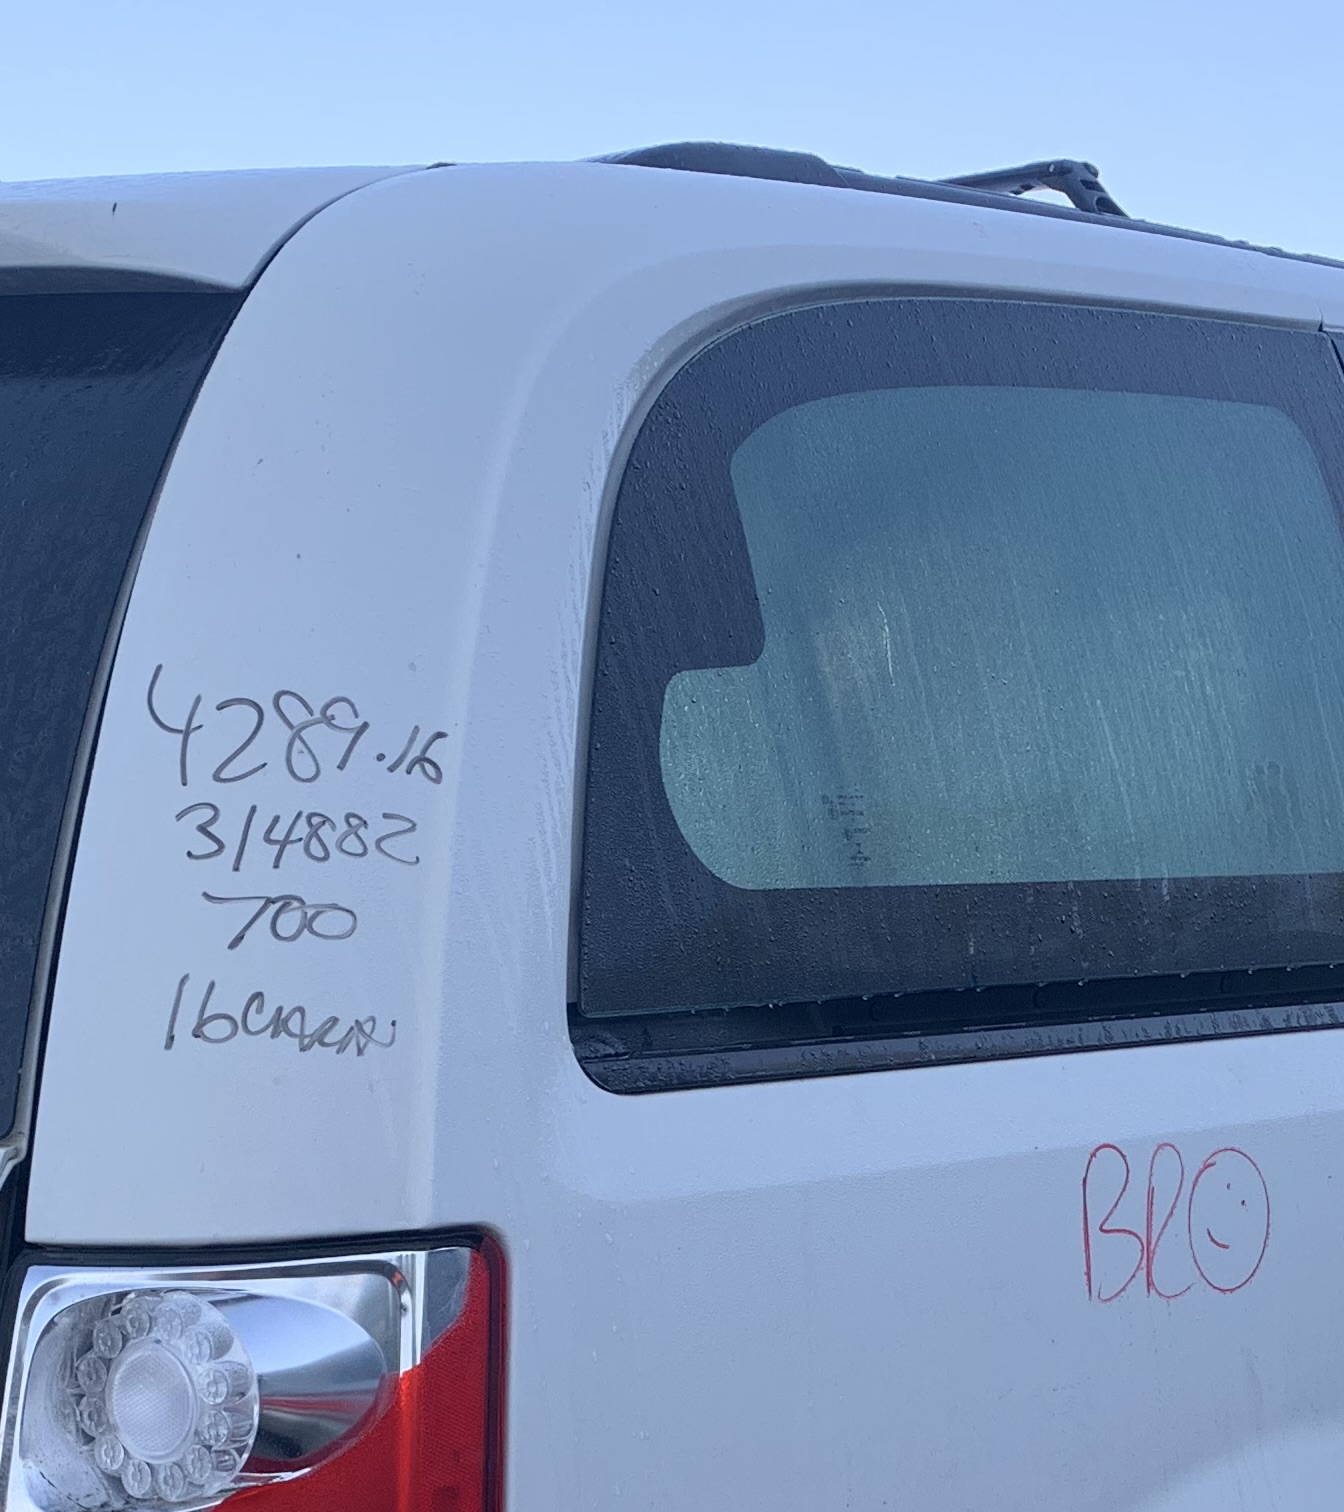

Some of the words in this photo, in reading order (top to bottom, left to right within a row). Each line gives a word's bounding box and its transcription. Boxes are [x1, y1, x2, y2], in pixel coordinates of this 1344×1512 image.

[146, 663, 449, 787] 4289.16
[174, 802, 421, 872] 314882
[201, 890, 358, 950] 700
